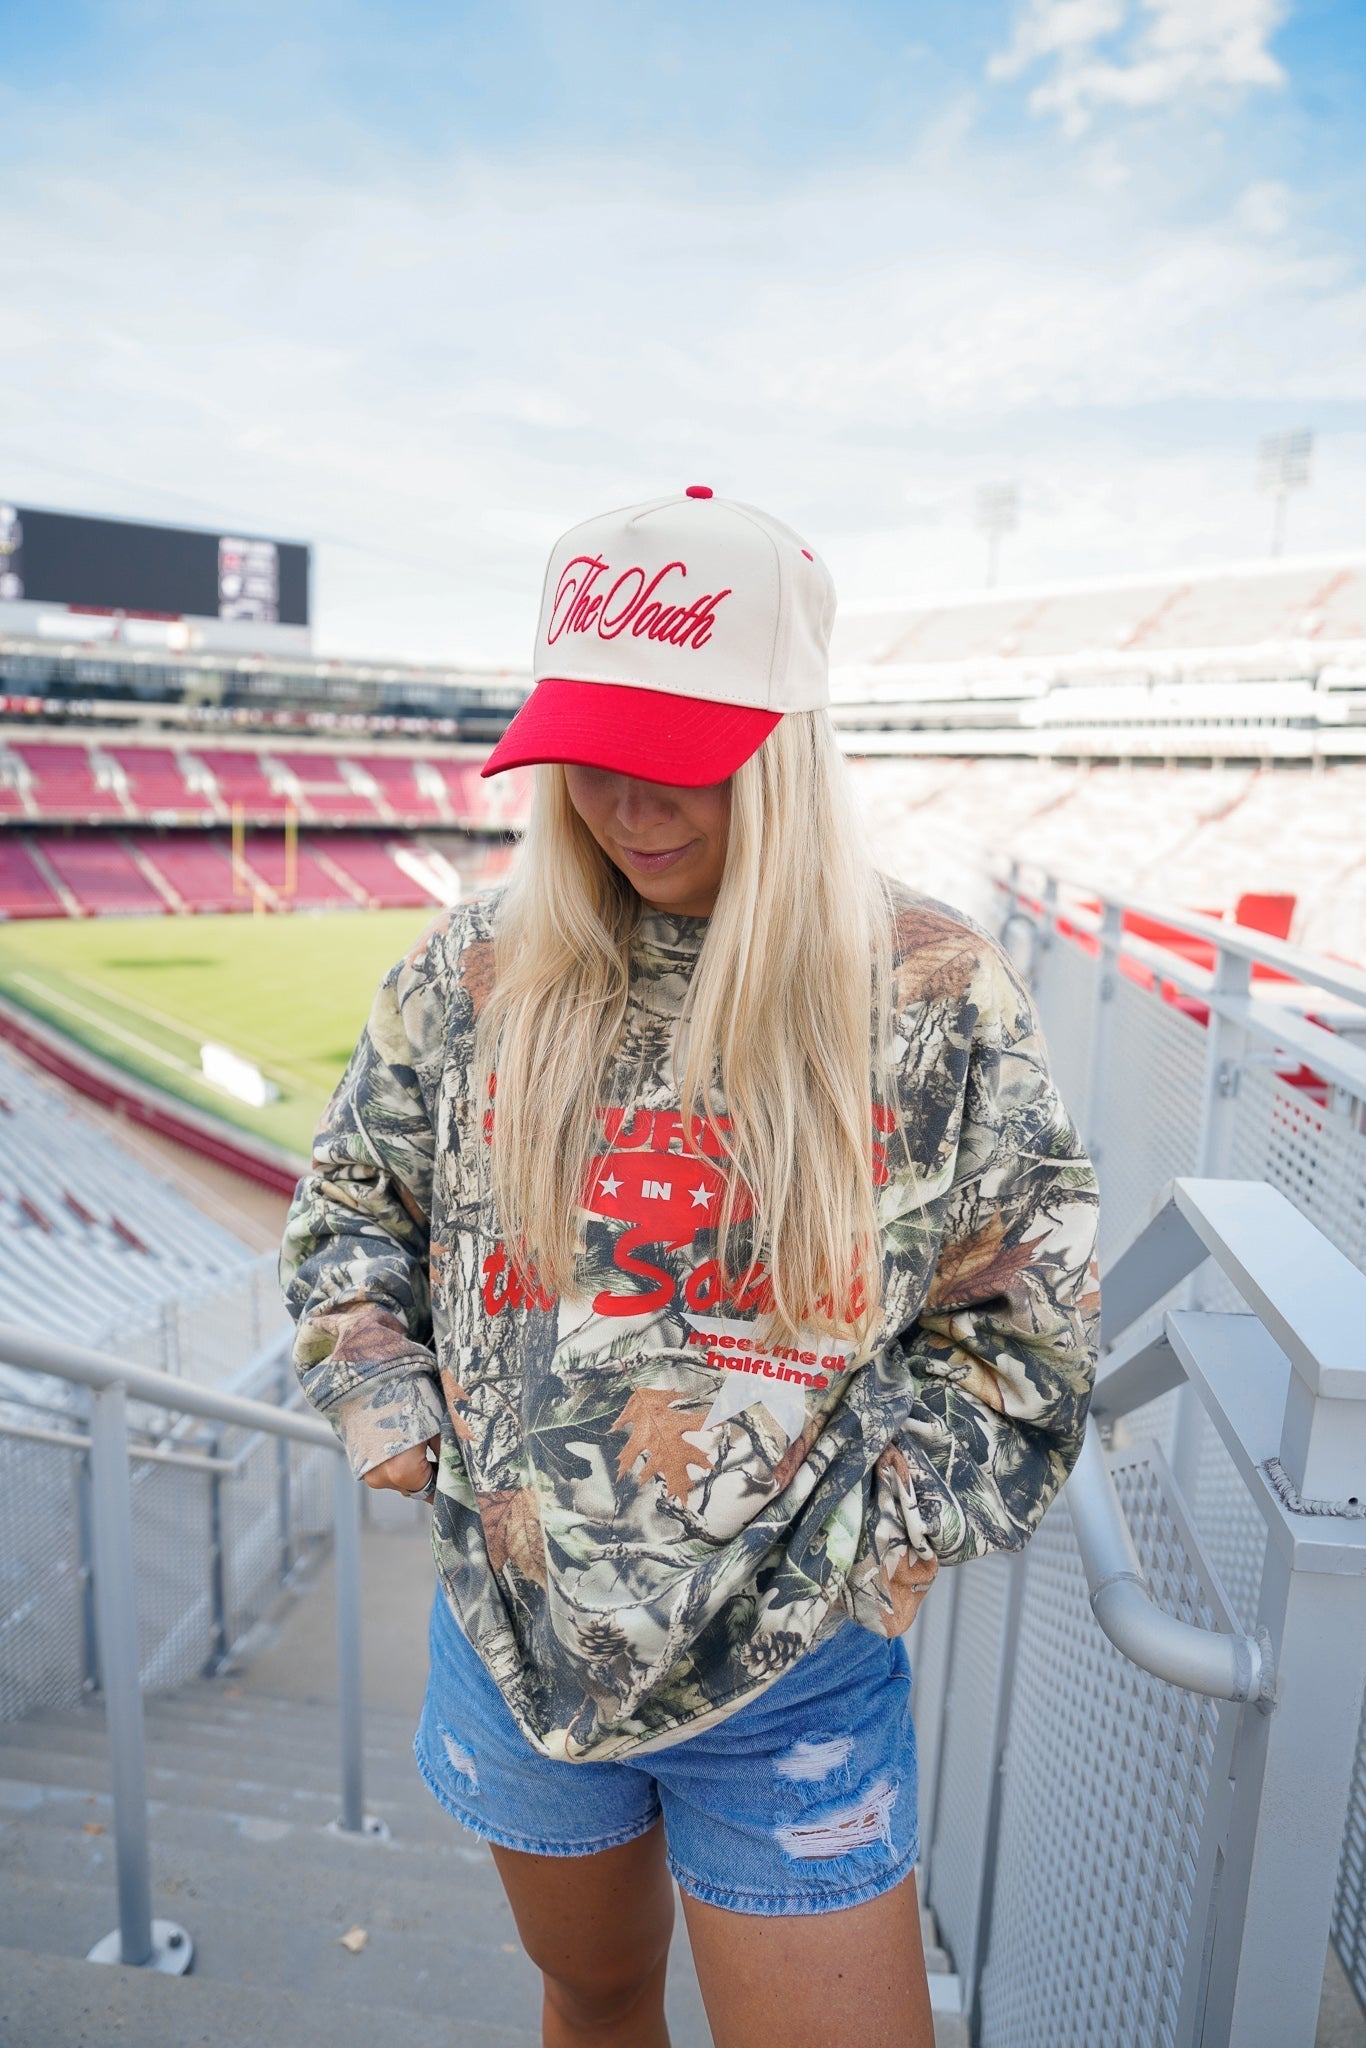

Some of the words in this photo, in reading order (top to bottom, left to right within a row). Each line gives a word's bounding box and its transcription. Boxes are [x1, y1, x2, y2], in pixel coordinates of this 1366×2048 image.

[548, 554, 609, 645] The
[598, 561, 732, 650] South
[641, 1180, 672, 1200] IN
[688, 1330, 768, 1355] meet
[772, 1344, 817, 1366] me
[821, 1354, 847, 1371] at
[706, 1351, 829, 1389] halftime
